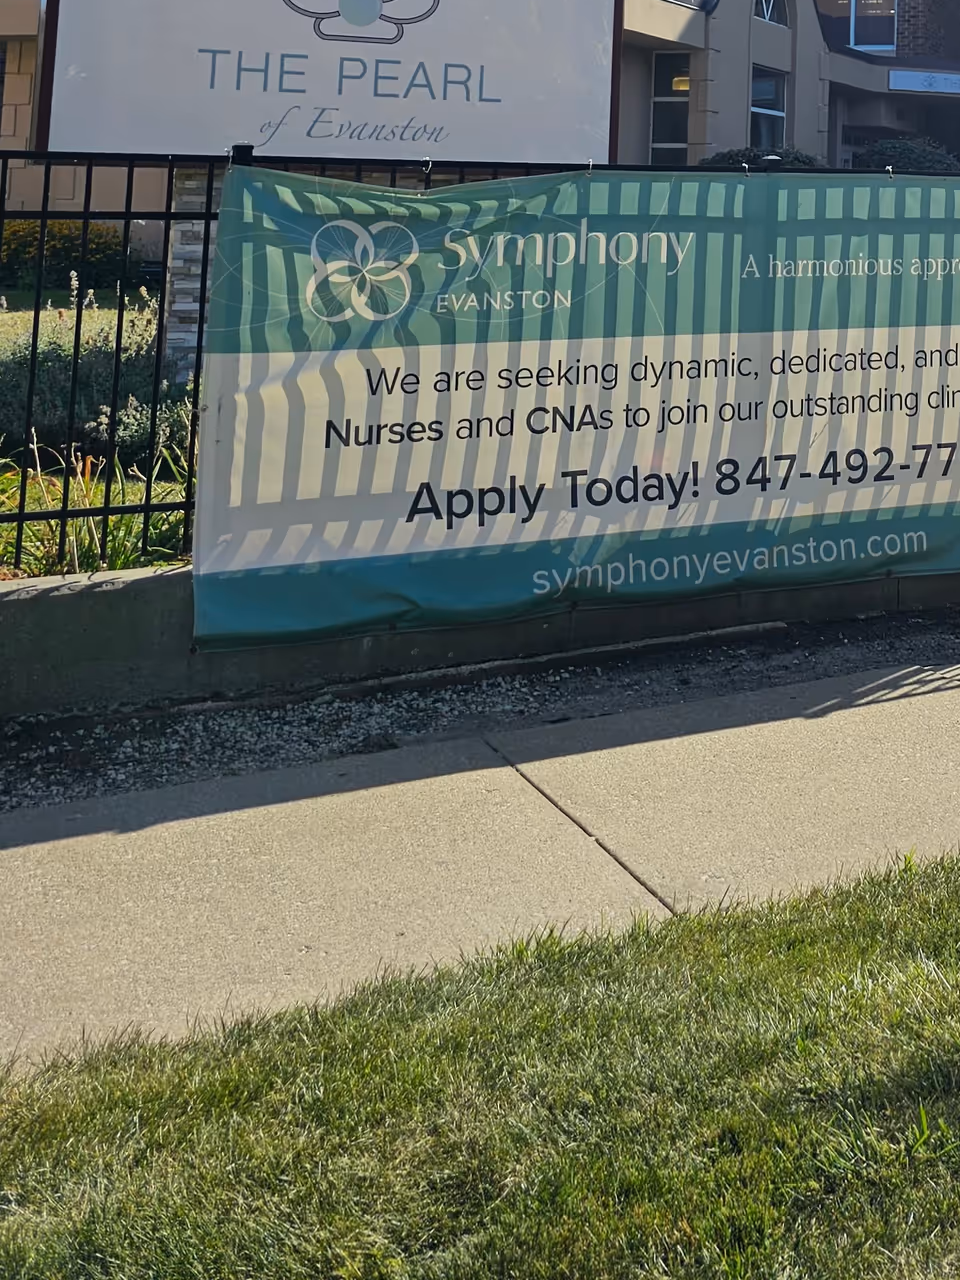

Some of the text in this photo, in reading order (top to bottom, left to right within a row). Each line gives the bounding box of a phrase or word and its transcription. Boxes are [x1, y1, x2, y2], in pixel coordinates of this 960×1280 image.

[197, 48, 502, 103] THE PEARL
[257, 105, 451, 147] of Evanston
[436, 218, 694, 282] Symphony
[741, 254, 761, 279] A
[767, 252, 904, 279] harmonious
[436, 289, 572, 314] EVANSTON
[366, 367, 421, 396] We
[432, 369, 485, 392] are
[497, 359, 619, 390] seeking
[630, 352, 760, 384] dynamic,
[769, 344, 906, 377] dedicated,
[914, 343, 960, 369] and
[324, 418, 444, 450] Nurses
[455, 409, 515, 440] and
[525, 404, 614, 436] CNAs
[622, 402, 651, 428] to
[656, 395, 709, 433] join
[717, 397, 764, 423] our
[771, 386, 919, 420] outstanding
[405, 475, 547, 530] Apply
[561, 459, 700, 510] Today!
[532, 528, 928, 597] symphonyevanston.com
